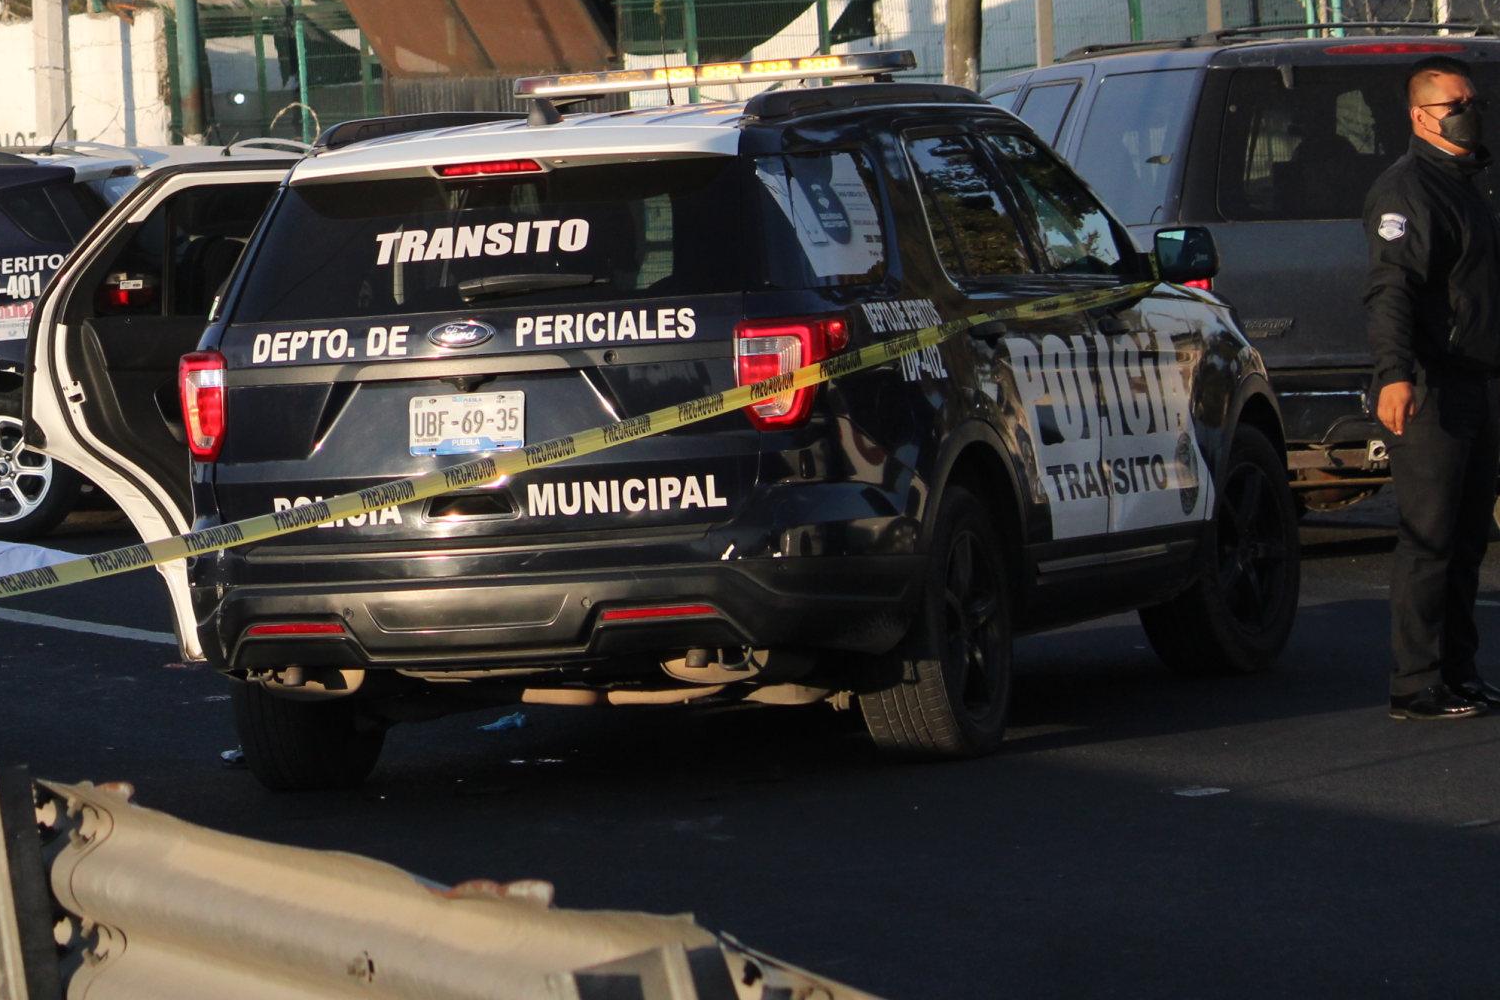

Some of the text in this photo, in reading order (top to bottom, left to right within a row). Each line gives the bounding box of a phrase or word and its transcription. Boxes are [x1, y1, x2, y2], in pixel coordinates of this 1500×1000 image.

[376, 218, 590, 266] TRANSITO
[252, 307, 697, 364] DEPTO. DE PERICIALES
[438, 324, 477, 342] Ford
[414, 407, 519, 438] UBF-69-35
[527, 474, 728, 518] MUNICIPAL
